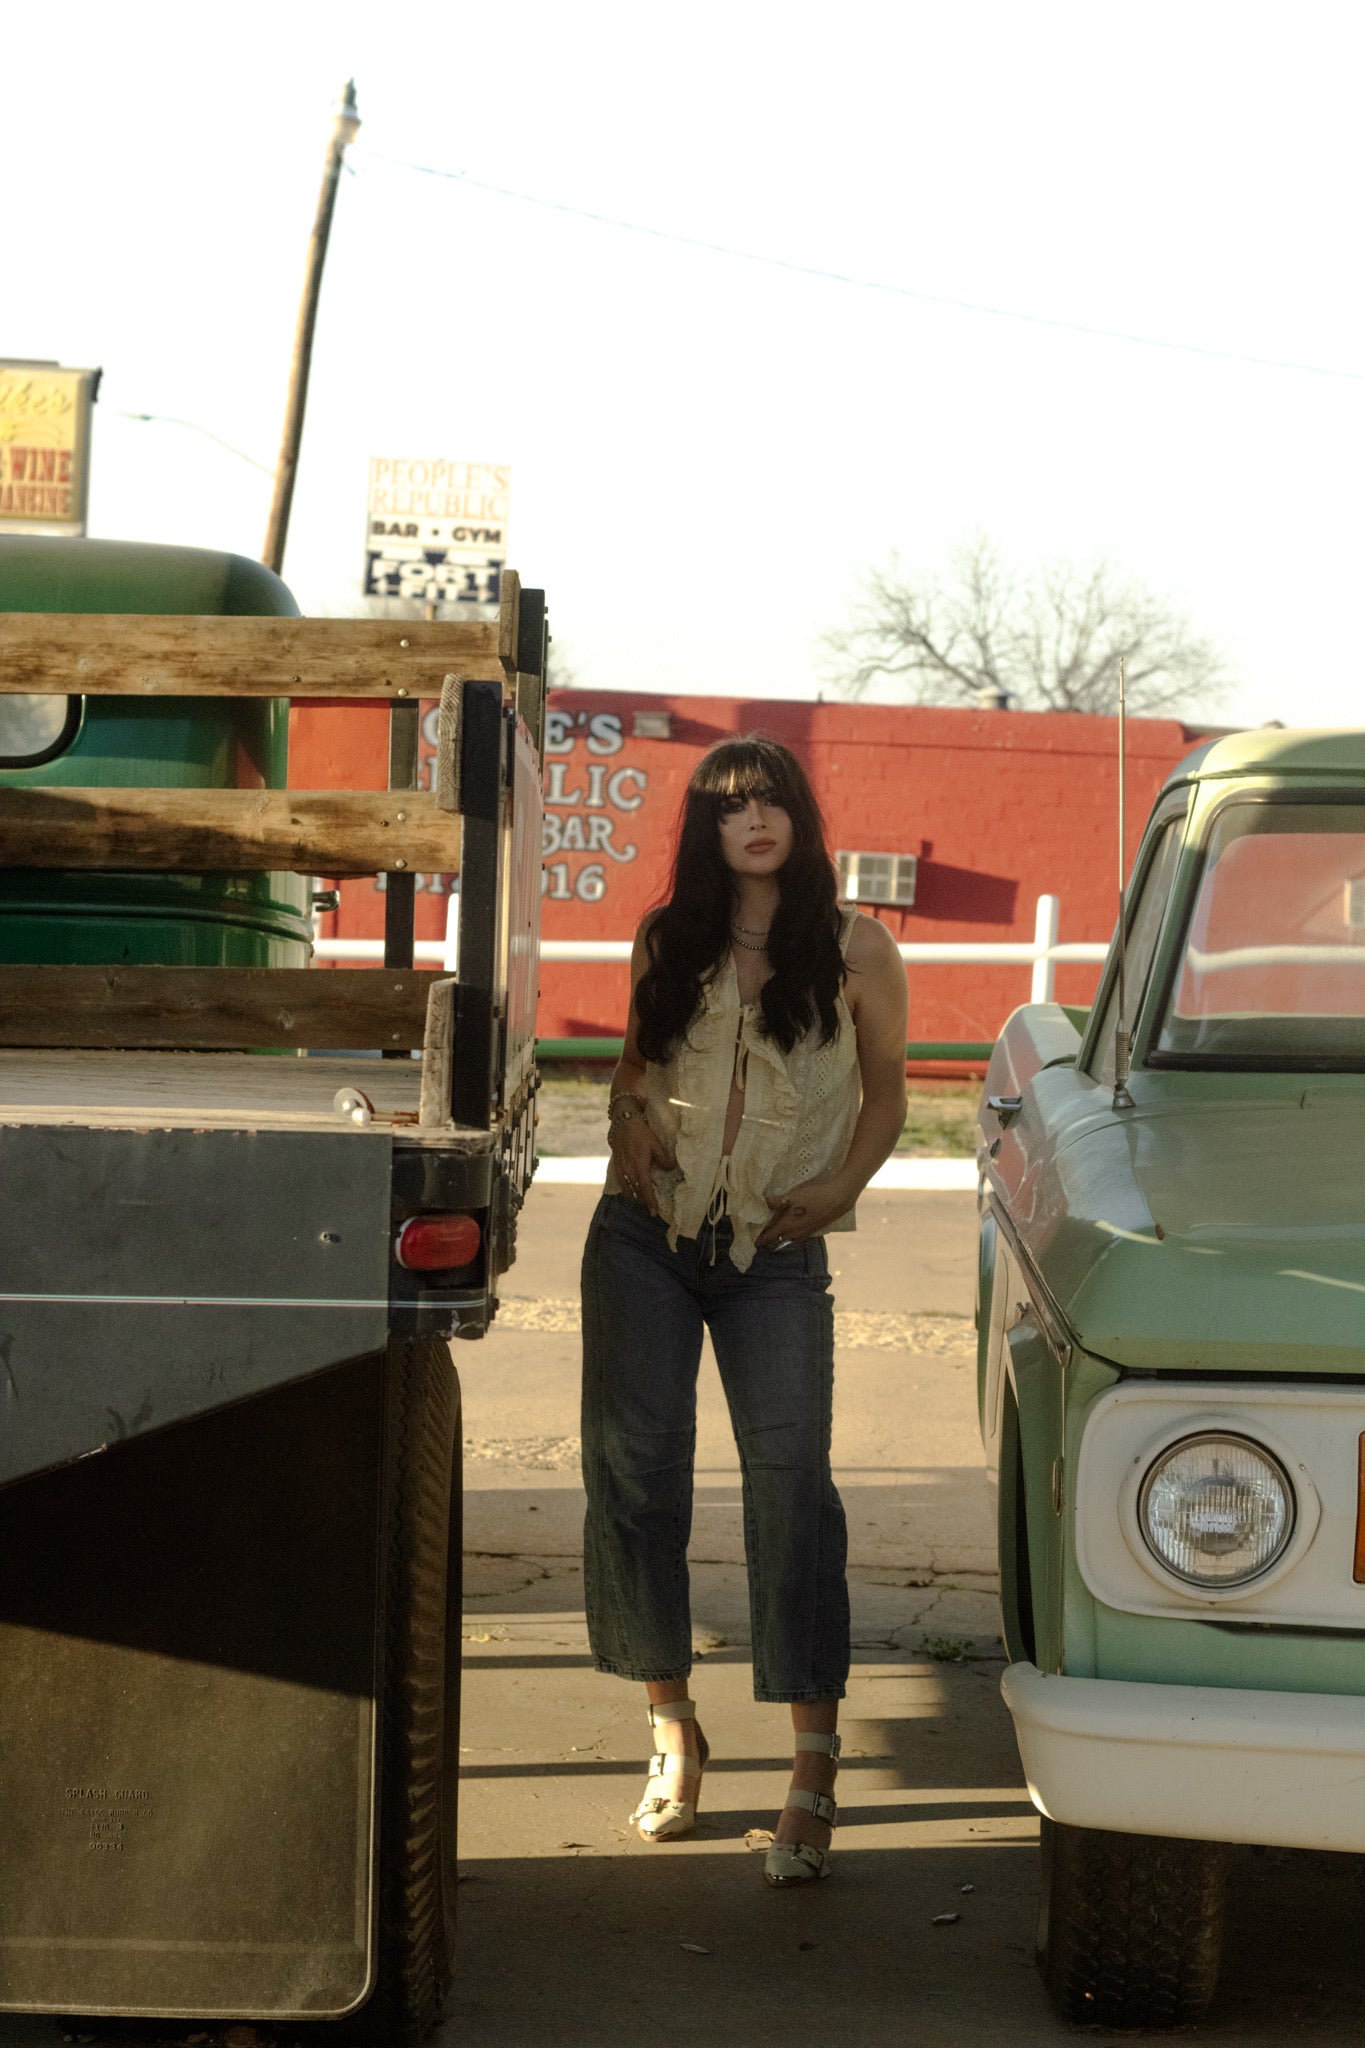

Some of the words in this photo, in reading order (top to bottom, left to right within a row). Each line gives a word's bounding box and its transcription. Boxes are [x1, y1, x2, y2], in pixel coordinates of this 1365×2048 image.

[10, 447, 71, 483] WINE
[374, 459, 509, 492] PEOPLE'S
[372, 488, 508, 521] REPUBLIC
[371, 520, 419, 538] BAR
[451, 526, 502, 544] GYM
[371, 559, 498, 591] FORT
[65, 1788, 108, 1799] SPLASH
[114, 1789, 150, 1800] GUARD
